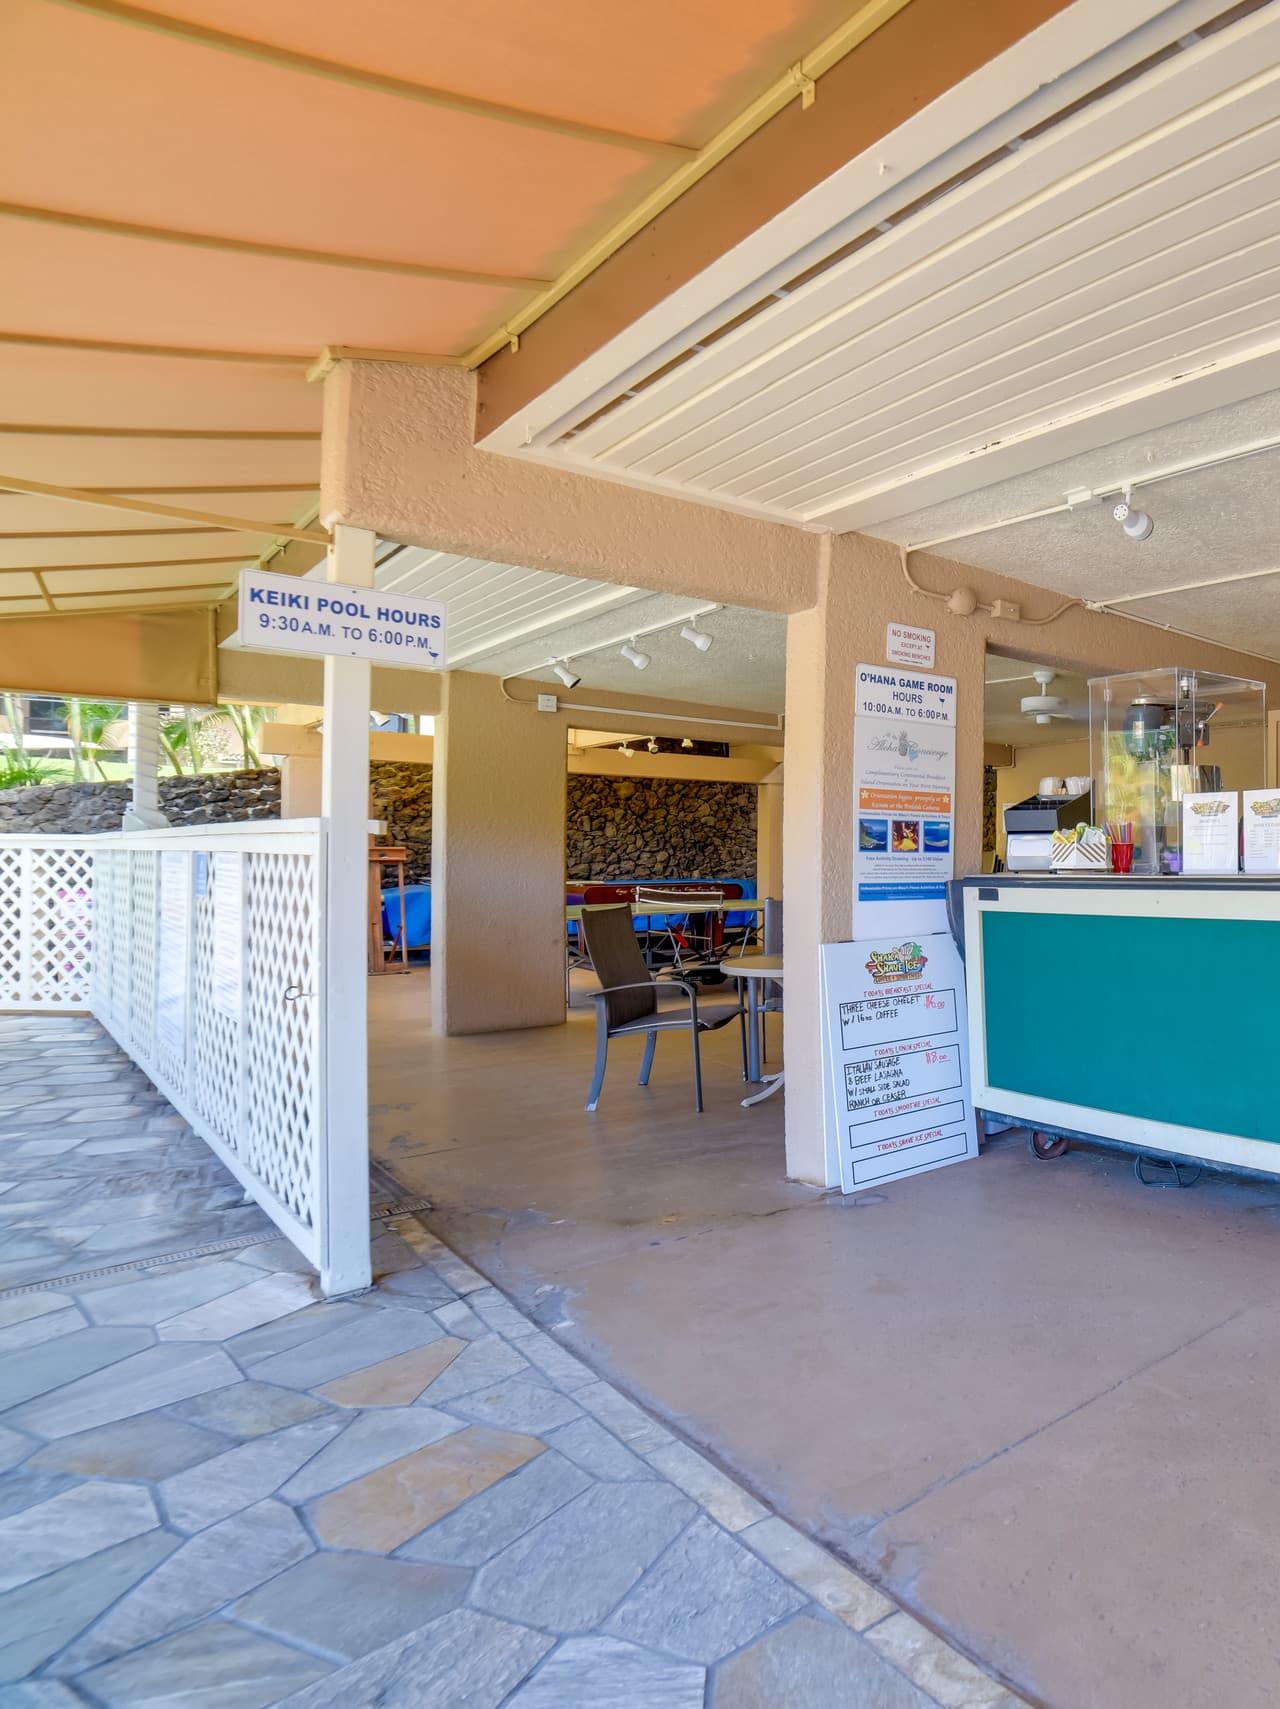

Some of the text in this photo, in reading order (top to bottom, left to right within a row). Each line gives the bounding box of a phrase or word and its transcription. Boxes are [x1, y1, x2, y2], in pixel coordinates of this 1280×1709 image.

[250, 587, 441, 629] KEIKI POOL HOURS
[342, 626, 363, 640] TO
[892, 629, 931, 643] NO SMOKING
[860, 672, 953, 695] O'HANA GAME ROOM
[892, 691, 923, 704] HOURS
[906, 708, 916, 717] TO
[870, 950, 900, 966] SHAKA
[873, 960, 919, 977] SHAVE ICE
[842, 1004, 864, 1015] THREE
[866, 1000, 890, 1011] CHEESE
[893, 996, 920, 1007] OMELET
[876, 1009, 898, 1020] COFFEE
[846, 1063, 872, 1076] ITALIAN
[874, 1057, 900, 1069] SAUSAGE
[854, 1074, 872, 1086] BEEF
[874, 1069, 903, 1081] LASAGNA
[878, 1082, 890, 1092] SIDE
[892, 1079, 910, 1089] SALAD
[849, 1096, 870, 1108] RANCH
[871, 1097, 880, 1106] OR
